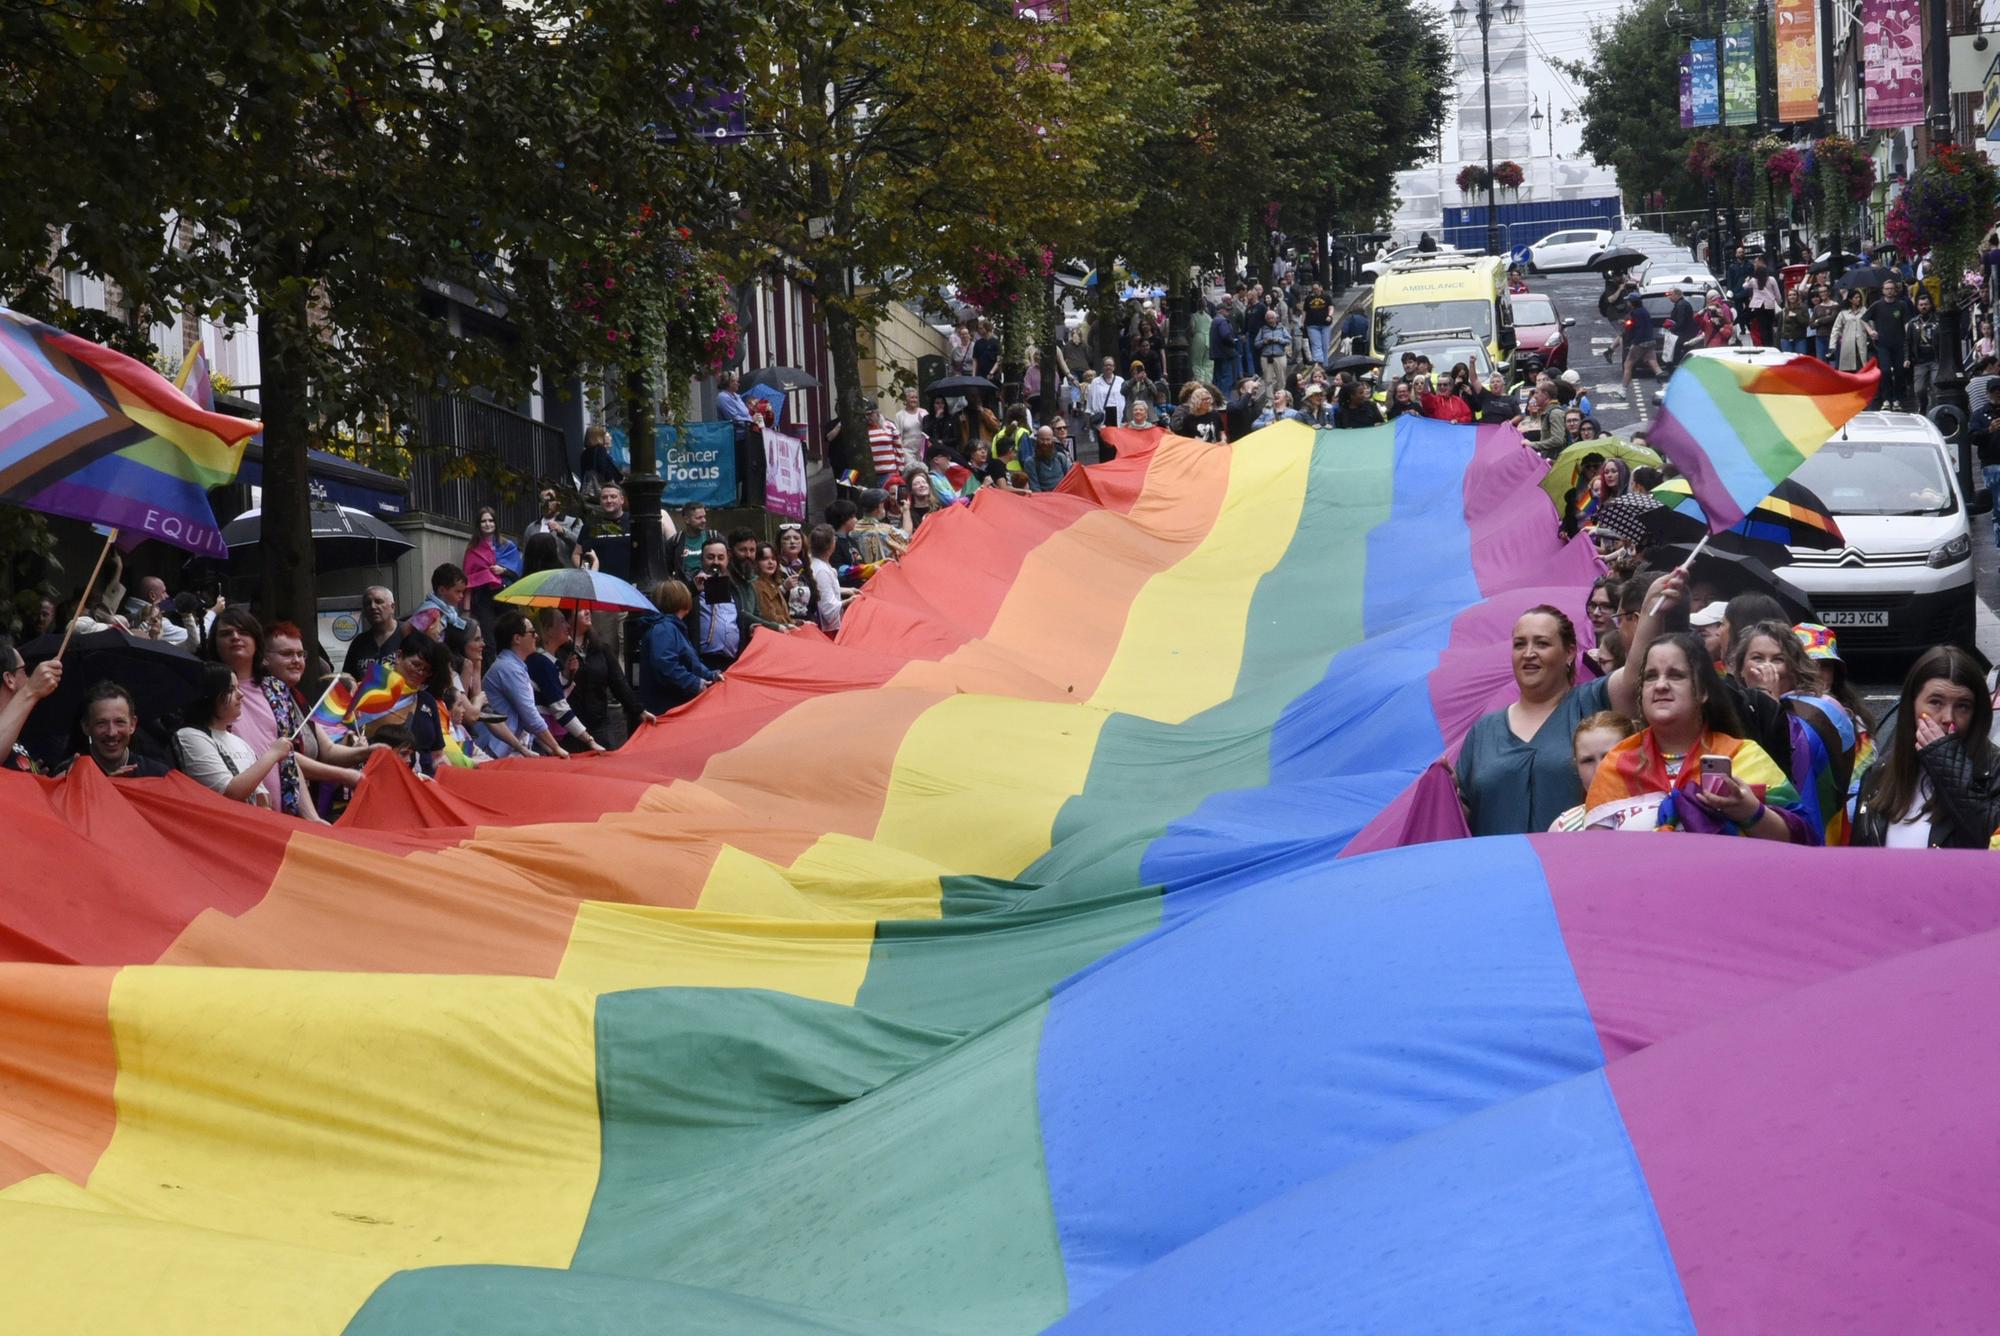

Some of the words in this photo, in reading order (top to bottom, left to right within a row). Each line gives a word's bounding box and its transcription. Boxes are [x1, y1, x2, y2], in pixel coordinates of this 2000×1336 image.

[1402, 282, 1464, 292] AMBULANCE
[667, 448, 719, 464] Cancer
[667, 464, 720, 481] Focus
[1823, 613, 1855, 624] CJ23
[1859, 613, 1883, 624] XCK
